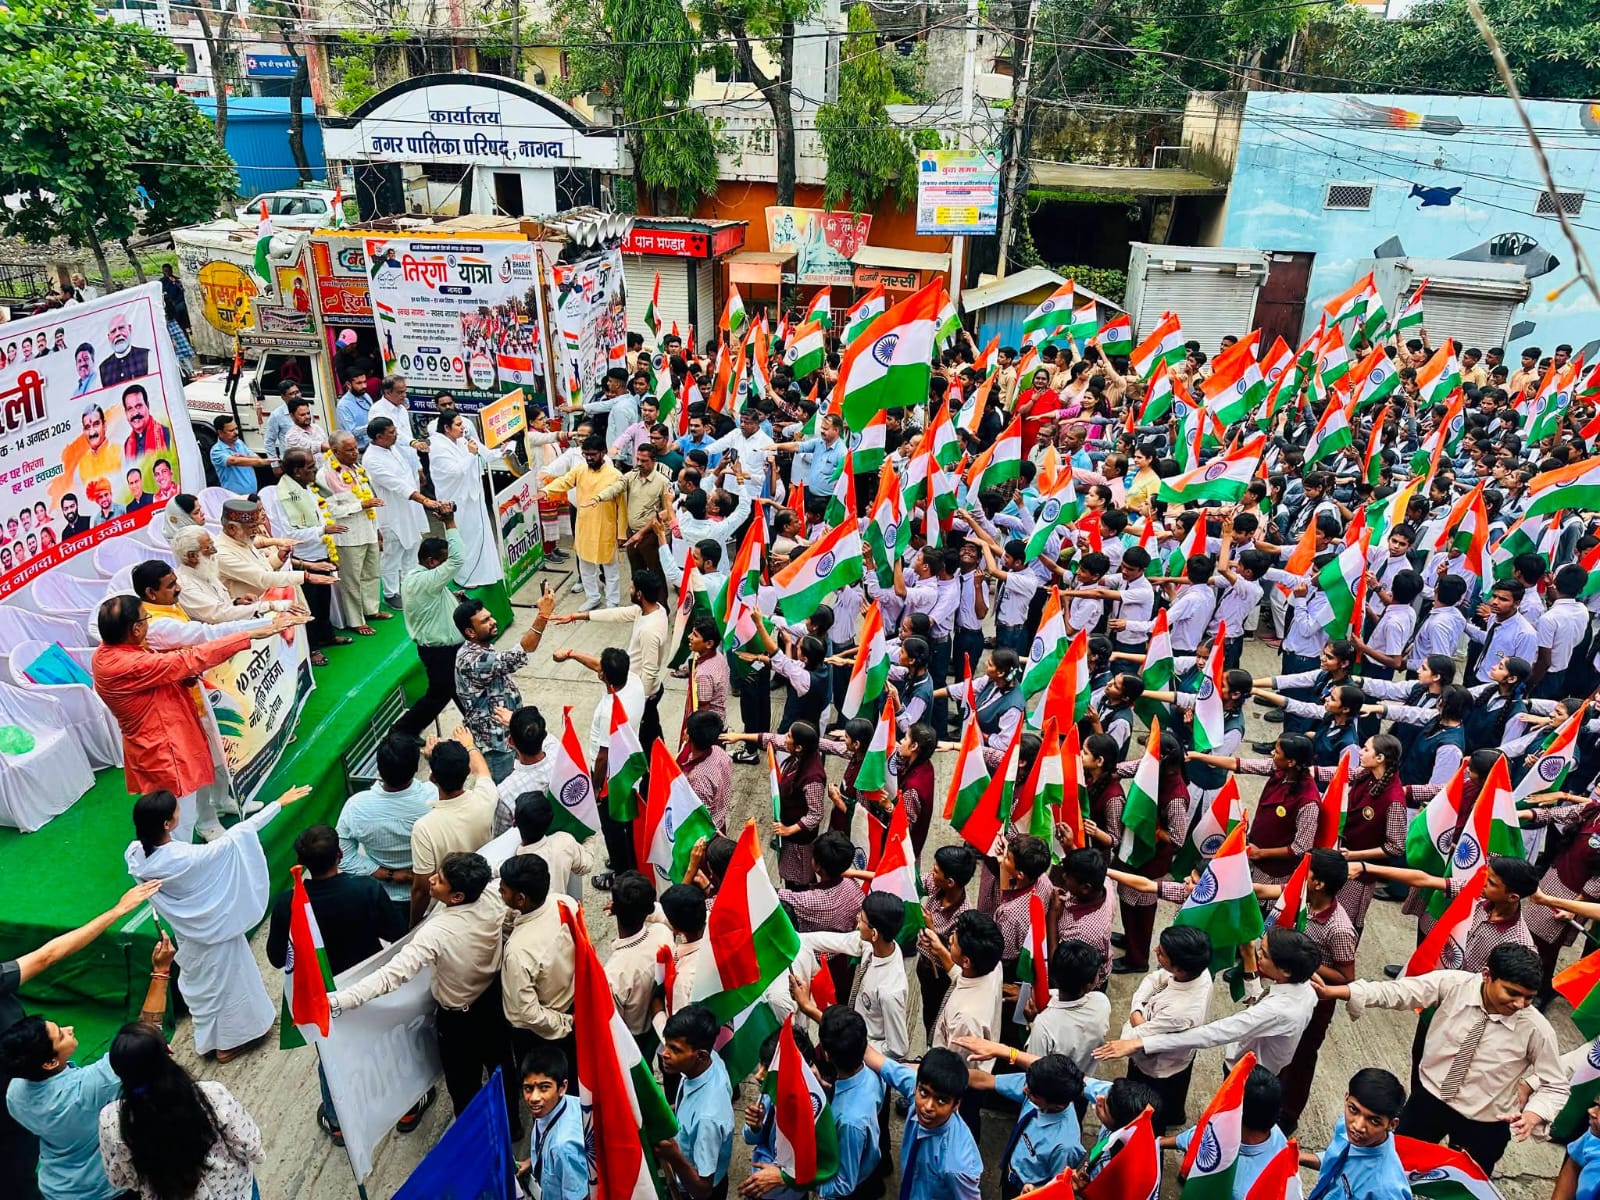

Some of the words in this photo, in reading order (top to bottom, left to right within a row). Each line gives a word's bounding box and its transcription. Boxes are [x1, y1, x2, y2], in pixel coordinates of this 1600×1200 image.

[430, 106, 501, 124] कार्यालय
[371, 136, 403, 153] नगर
[406, 132, 461, 155] पालिका
[518, 141, 564, 158] नागदा
[635, 236, 654, 248] पान
[656, 237, 686, 252] भण्डार
[402, 254, 448, 289] तिरंगा
[457, 263, 493, 284] यात्रा
[880, 272, 915, 288] लस्सी
[16, 439, 25, 451] 14
[27, 428, 50, 447] अगस्त
[51, 420, 71, 437] 2026
[9, 468, 20, 479] घर
[12, 482, 22, 495] हर
[23, 477, 34, 488] घर
[36, 464, 63, 483] स्वच्छता
[59, 535, 94, 558] जिला
[97, 518, 136, 541] उज्जैन
[508, 537, 528, 565] तिरंगा
